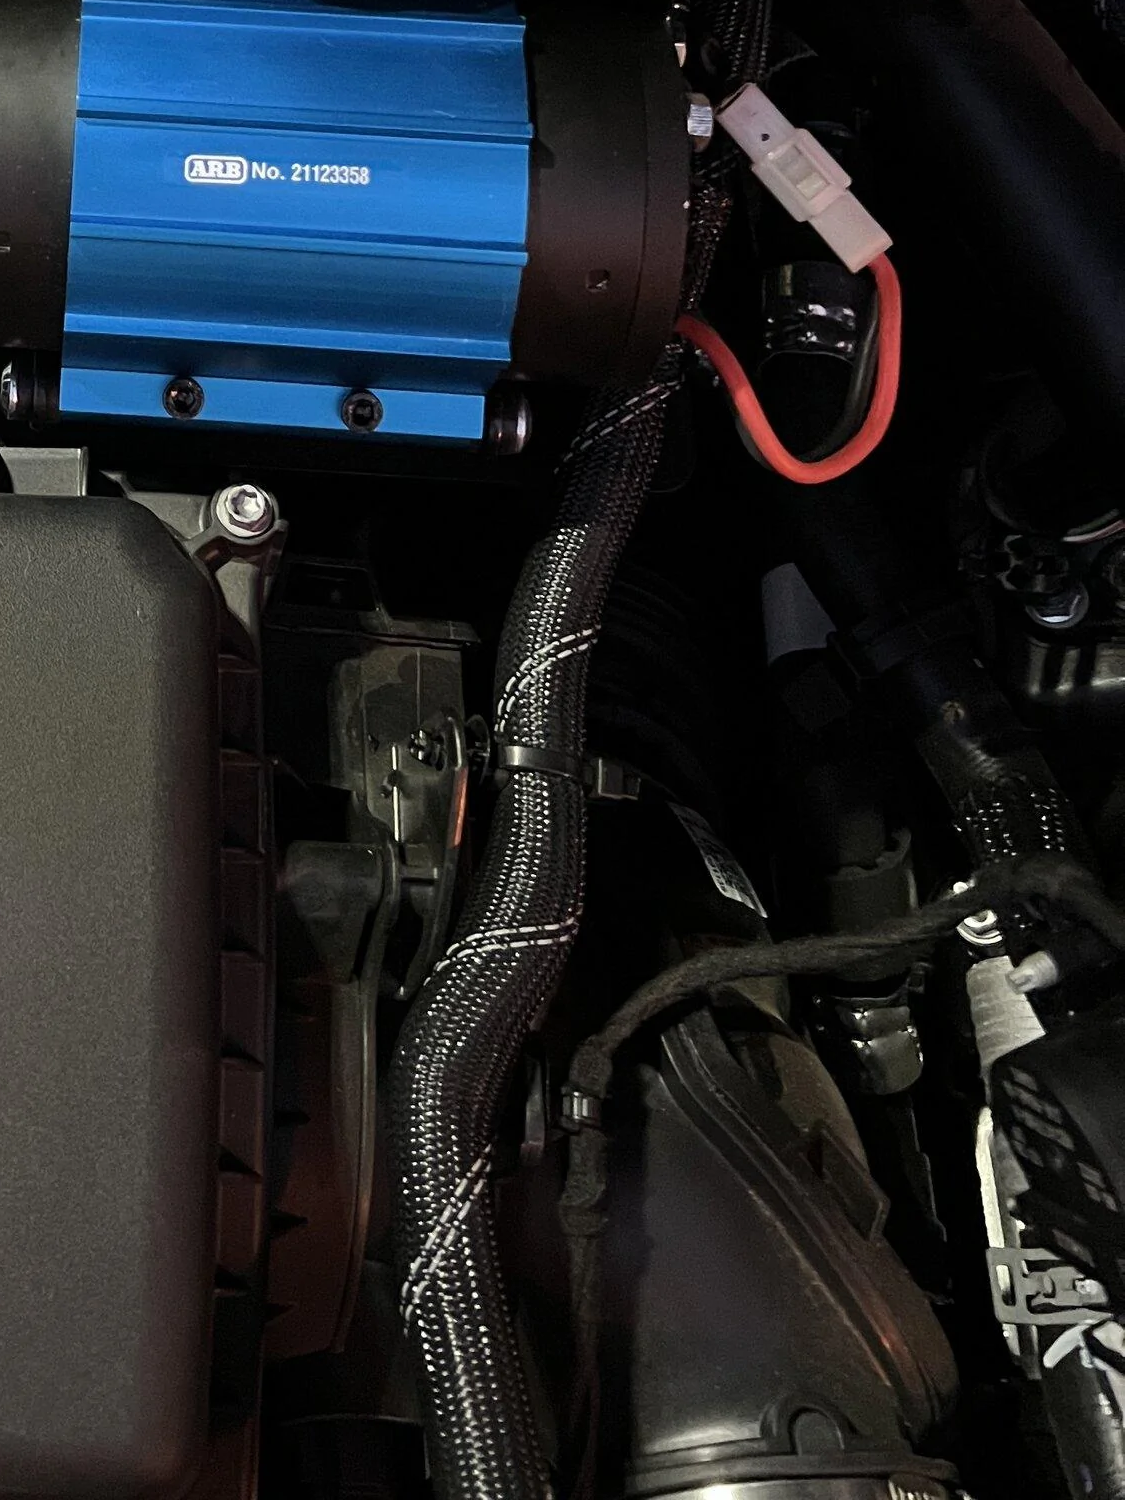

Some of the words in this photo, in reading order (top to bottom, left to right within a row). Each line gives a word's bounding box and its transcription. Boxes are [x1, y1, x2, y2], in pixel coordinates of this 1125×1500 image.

[189, 159, 242, 179] ARB
[251, 161, 286, 181] No.
[291, 162, 371, 186] 21123358
